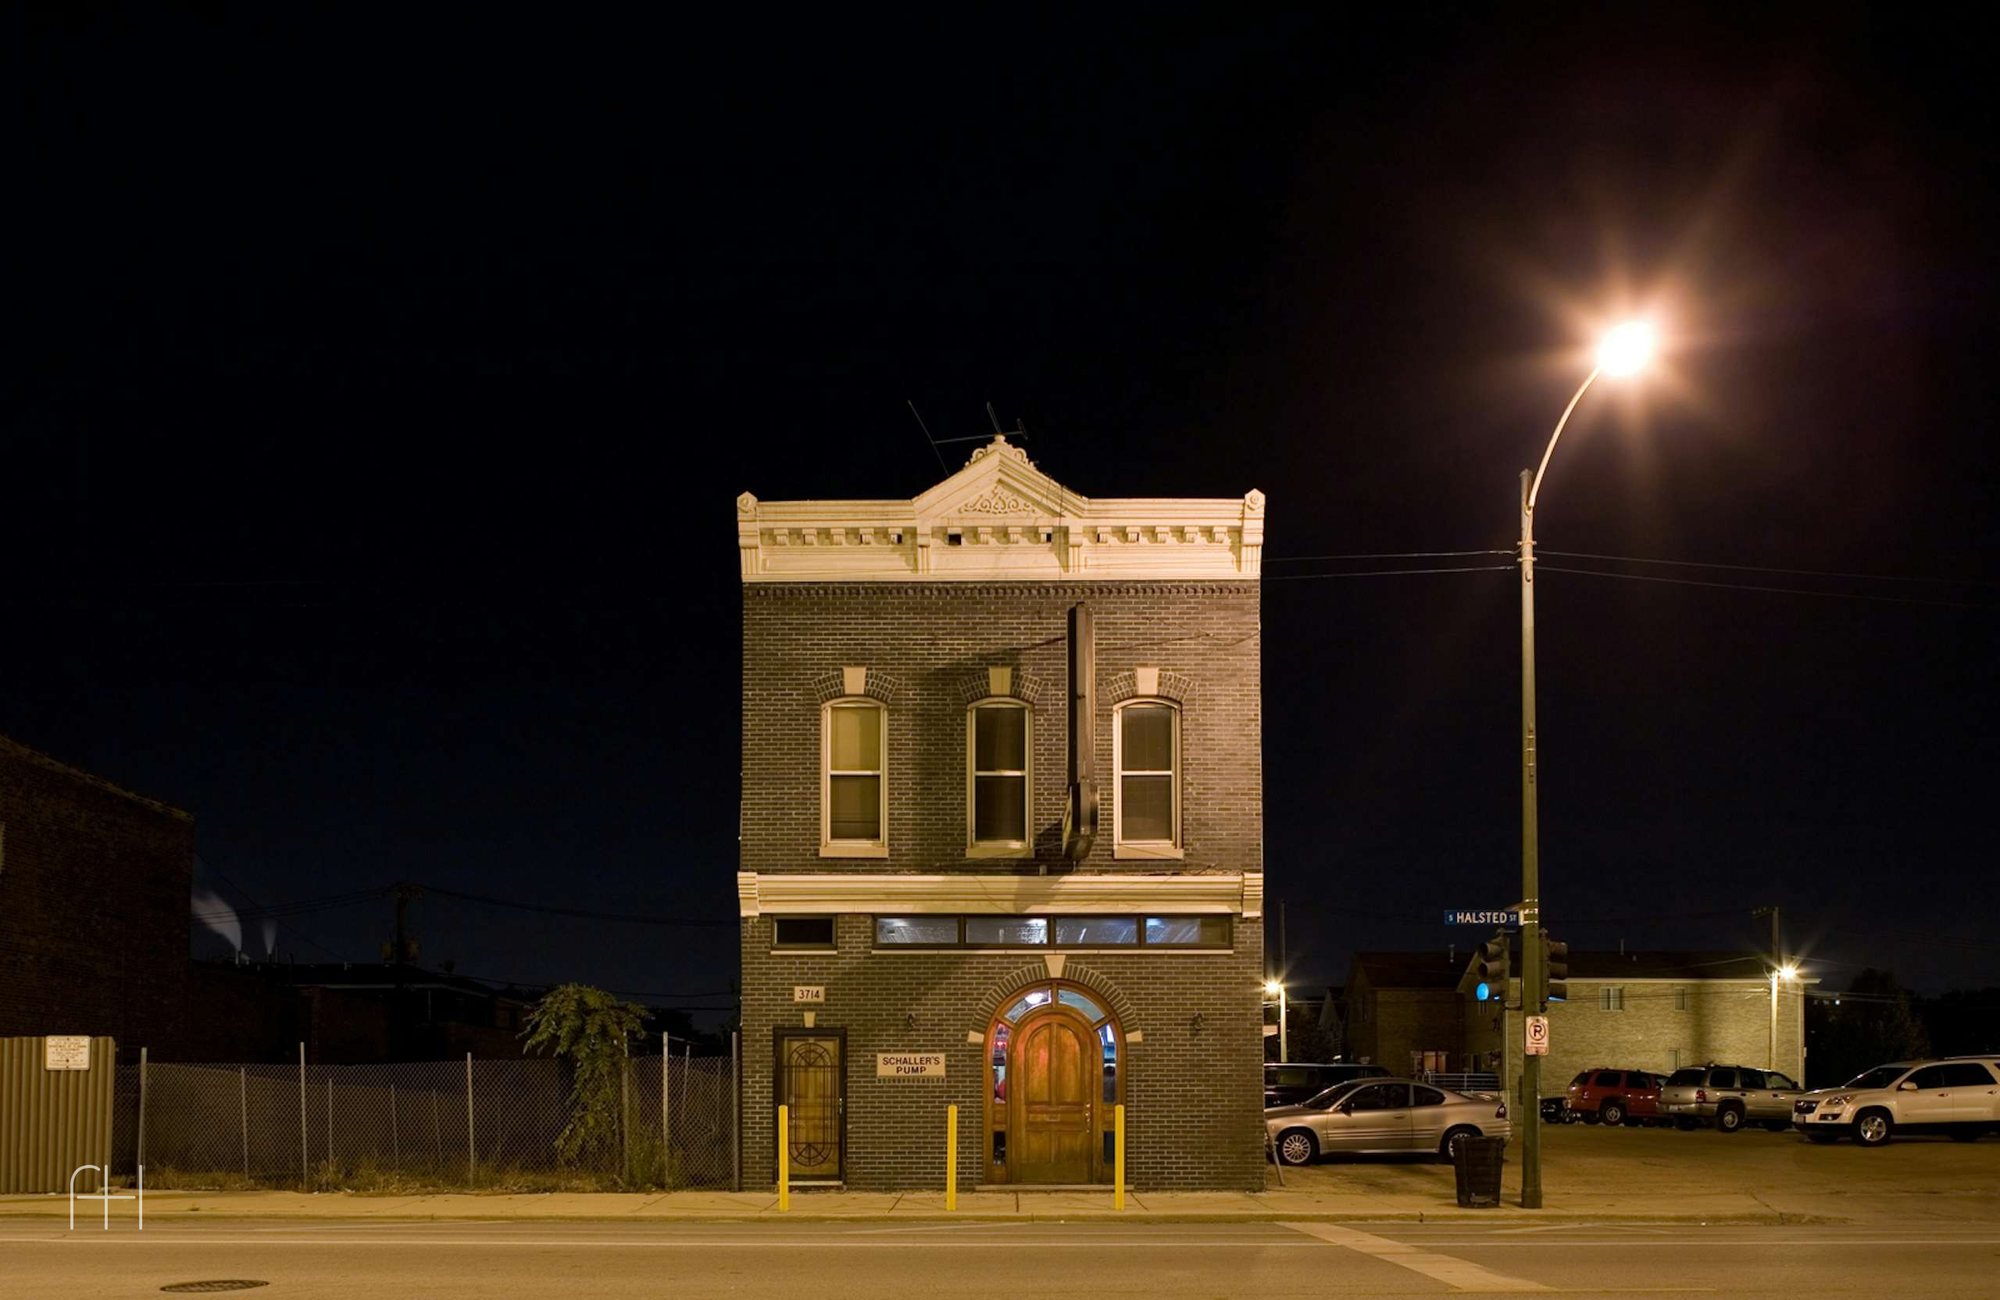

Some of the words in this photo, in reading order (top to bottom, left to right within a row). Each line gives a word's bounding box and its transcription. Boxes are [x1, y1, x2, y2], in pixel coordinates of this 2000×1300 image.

[1456, 911, 1508, 924] HALSTED
[1509, 914, 1518, 922] ST
[798, 989, 820, 1000] 3714
[882, 1056, 941, 1066] SCHALLER'S
[896, 1066, 927, 1074] PUMP
